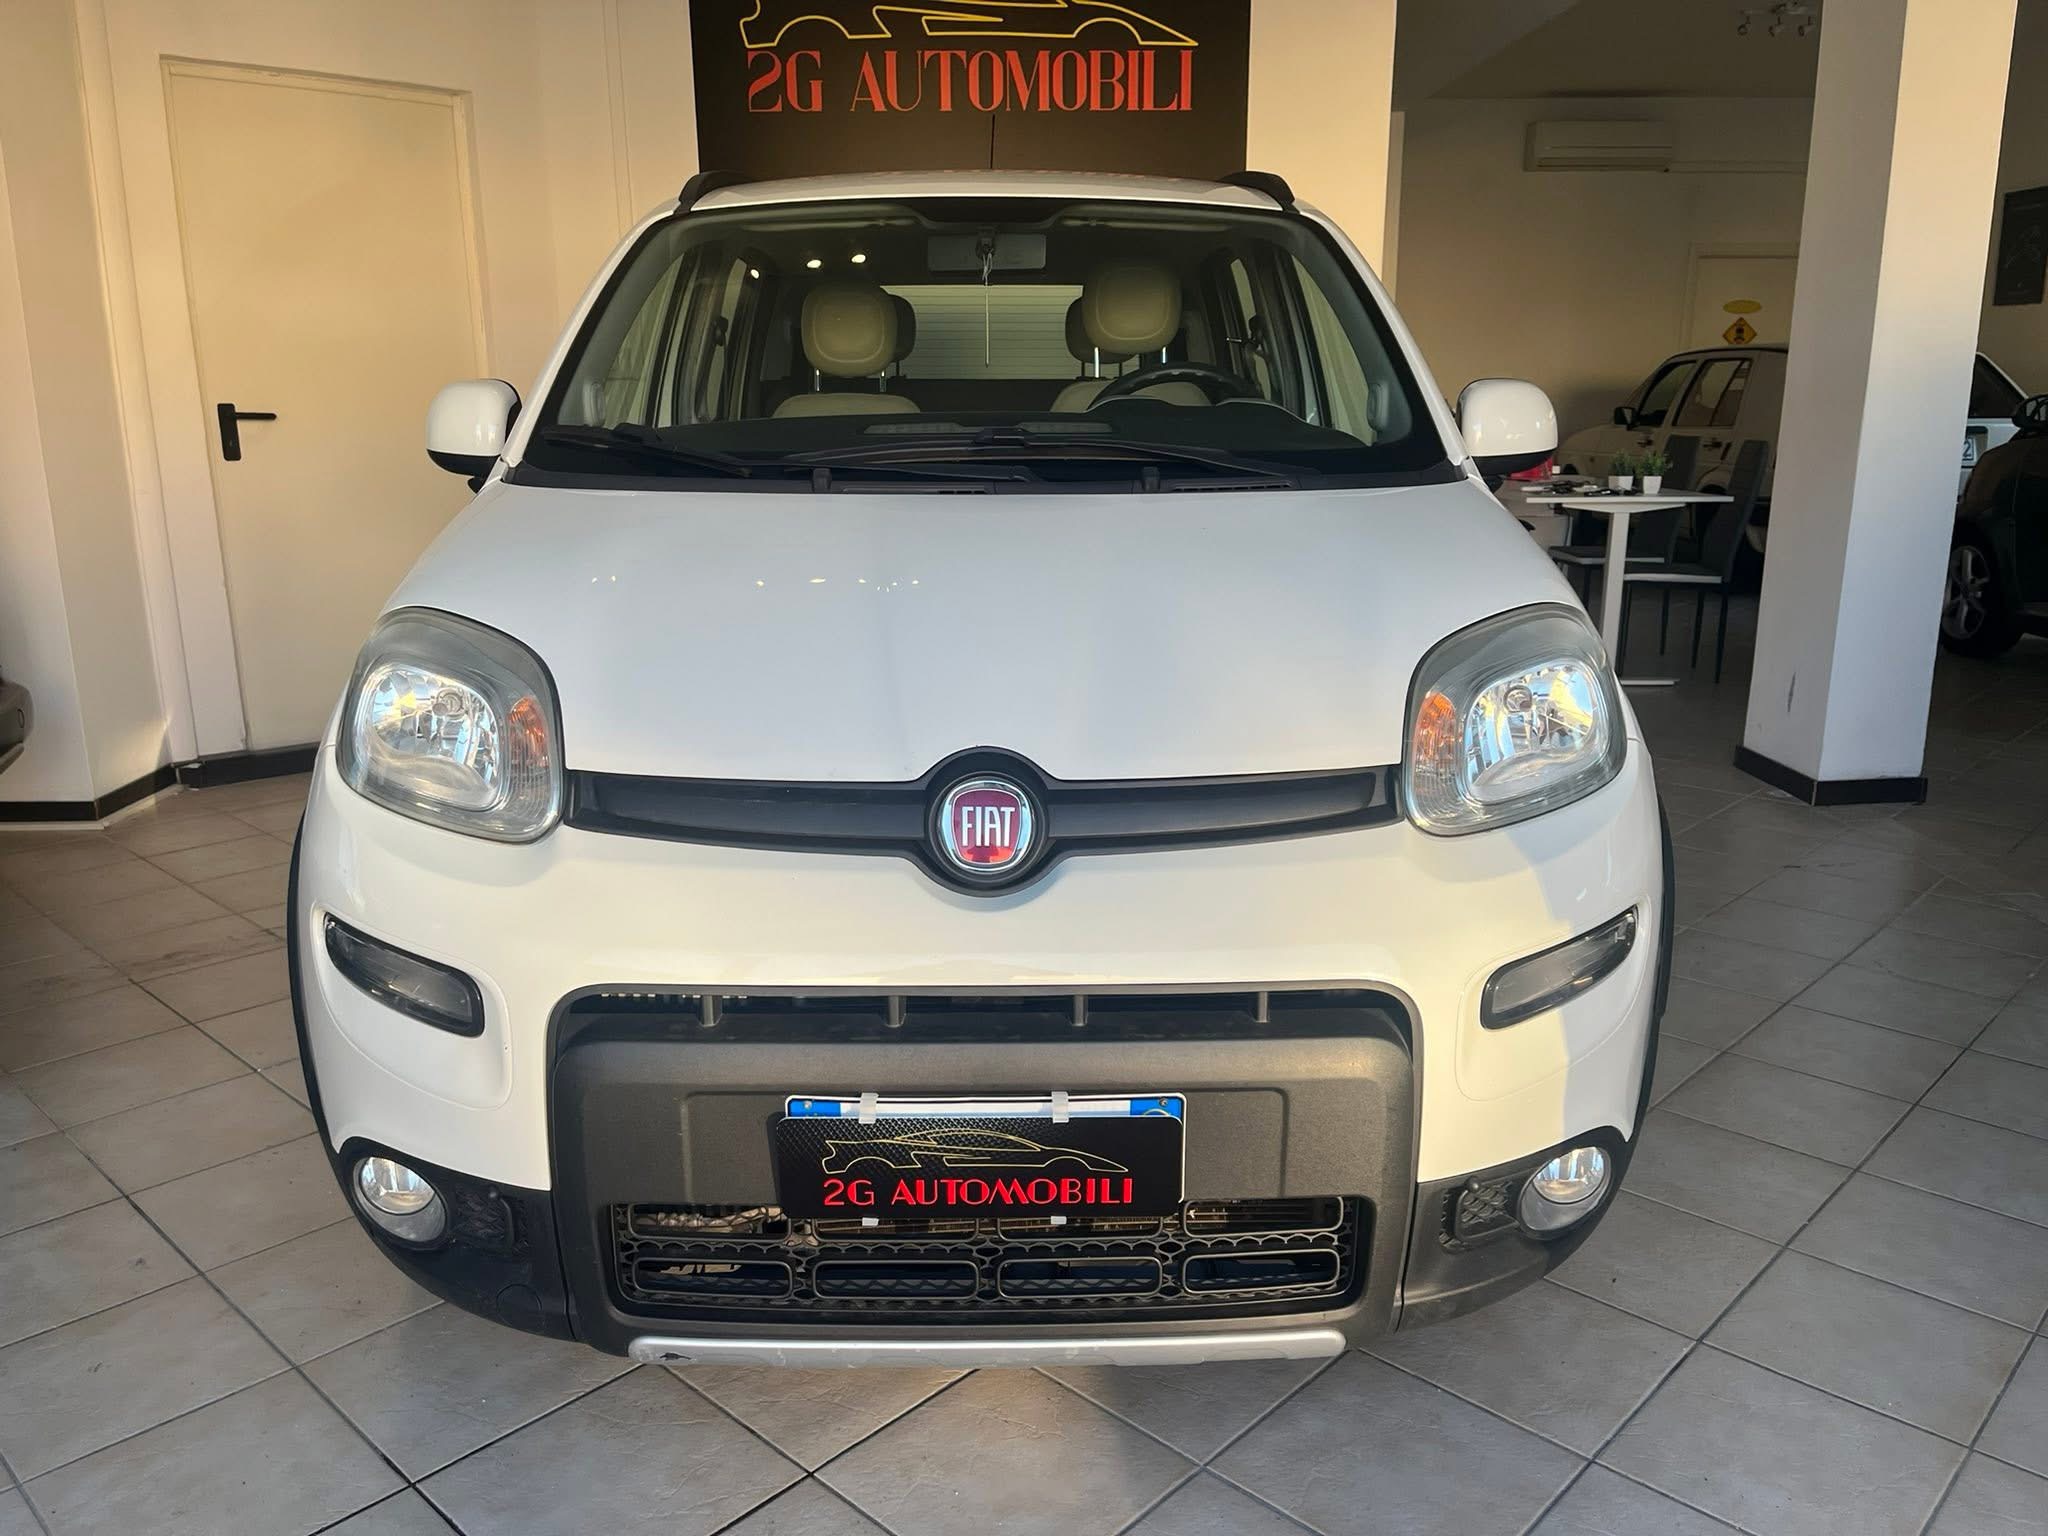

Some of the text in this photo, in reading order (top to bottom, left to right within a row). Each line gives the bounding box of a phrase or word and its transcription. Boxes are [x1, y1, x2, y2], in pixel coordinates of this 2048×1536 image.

[747, 49, 1194, 112] 2G AUTOMOBILI
[961, 806, 1016, 847] FIAT
[823, 1178, 1133, 1205] 2G AUTOMOBILI
